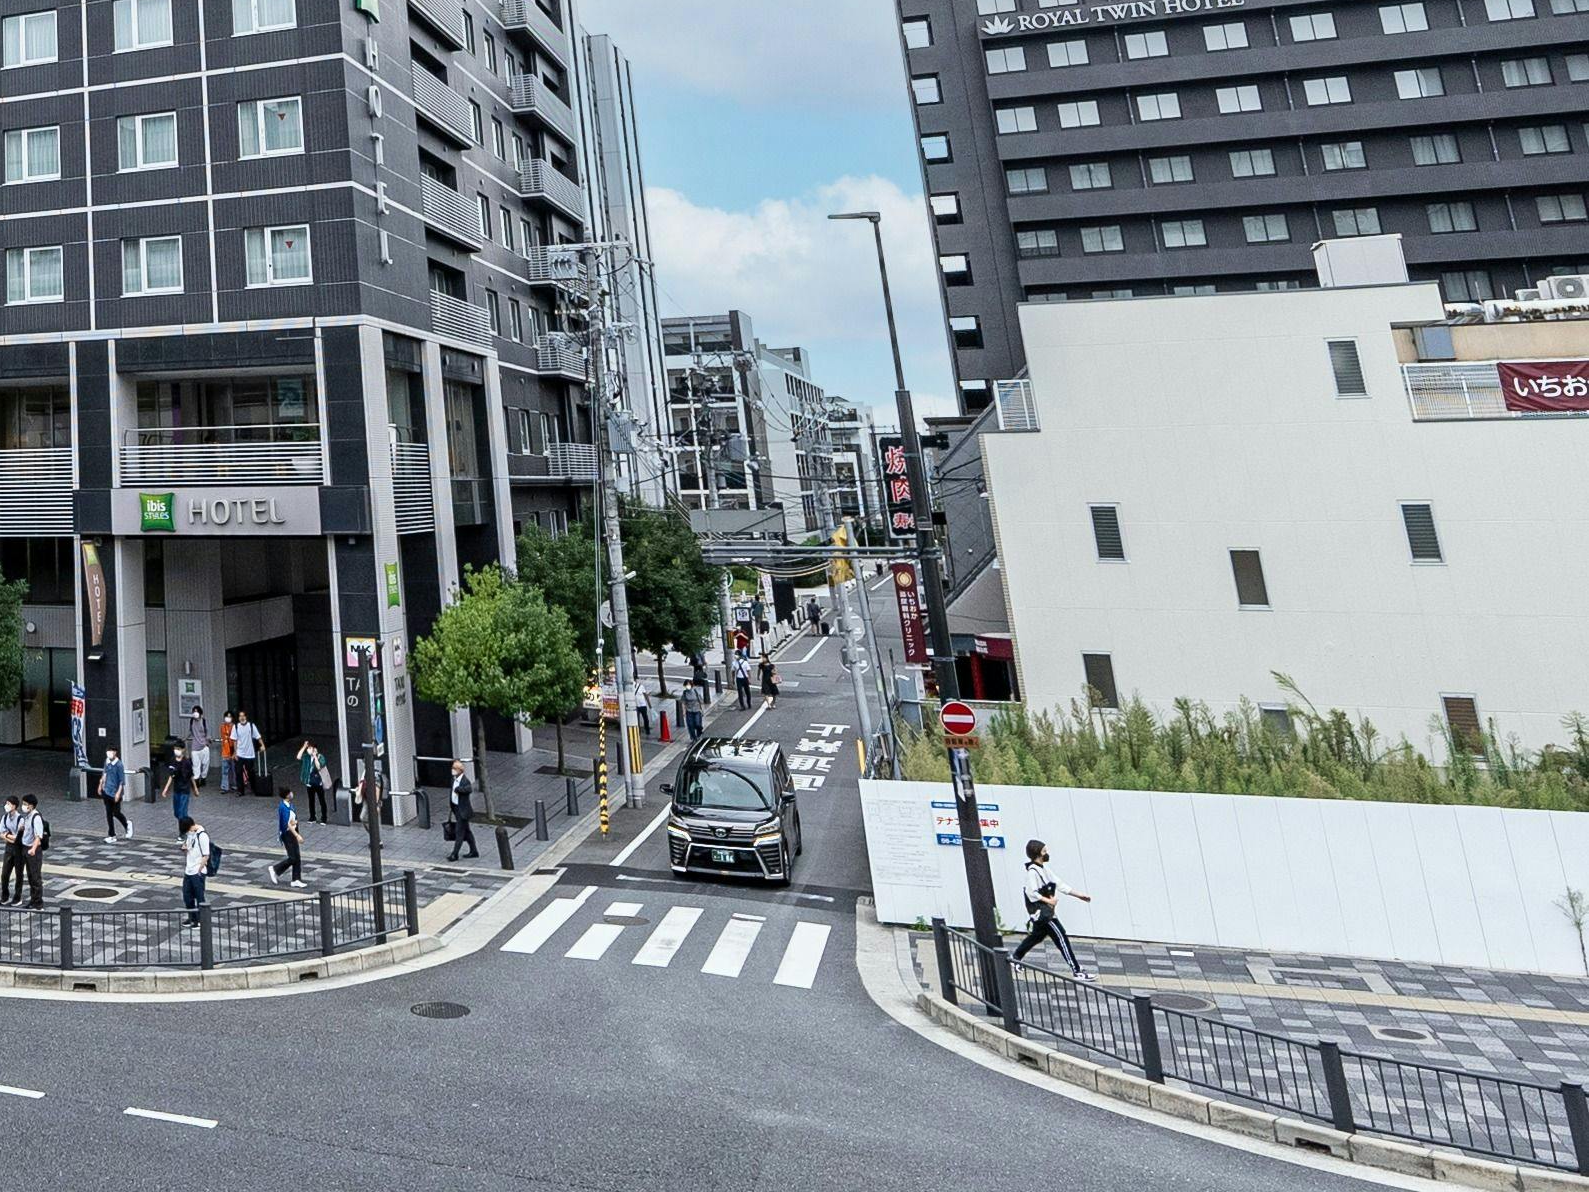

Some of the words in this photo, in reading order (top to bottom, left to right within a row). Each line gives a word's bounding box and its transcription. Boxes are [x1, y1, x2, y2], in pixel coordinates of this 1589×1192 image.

[1017, 8, 1090, 31] ROYAL
[1091, 0, 1158, 21] TWIN
[1514, 374, 1589, 397] いちお
[147, 500, 166, 512] ibis
[188, 497, 286, 525] HOTEL
[92, 573, 102, 635] HOTEL
[936, 816, 999, 829] テナ集中
